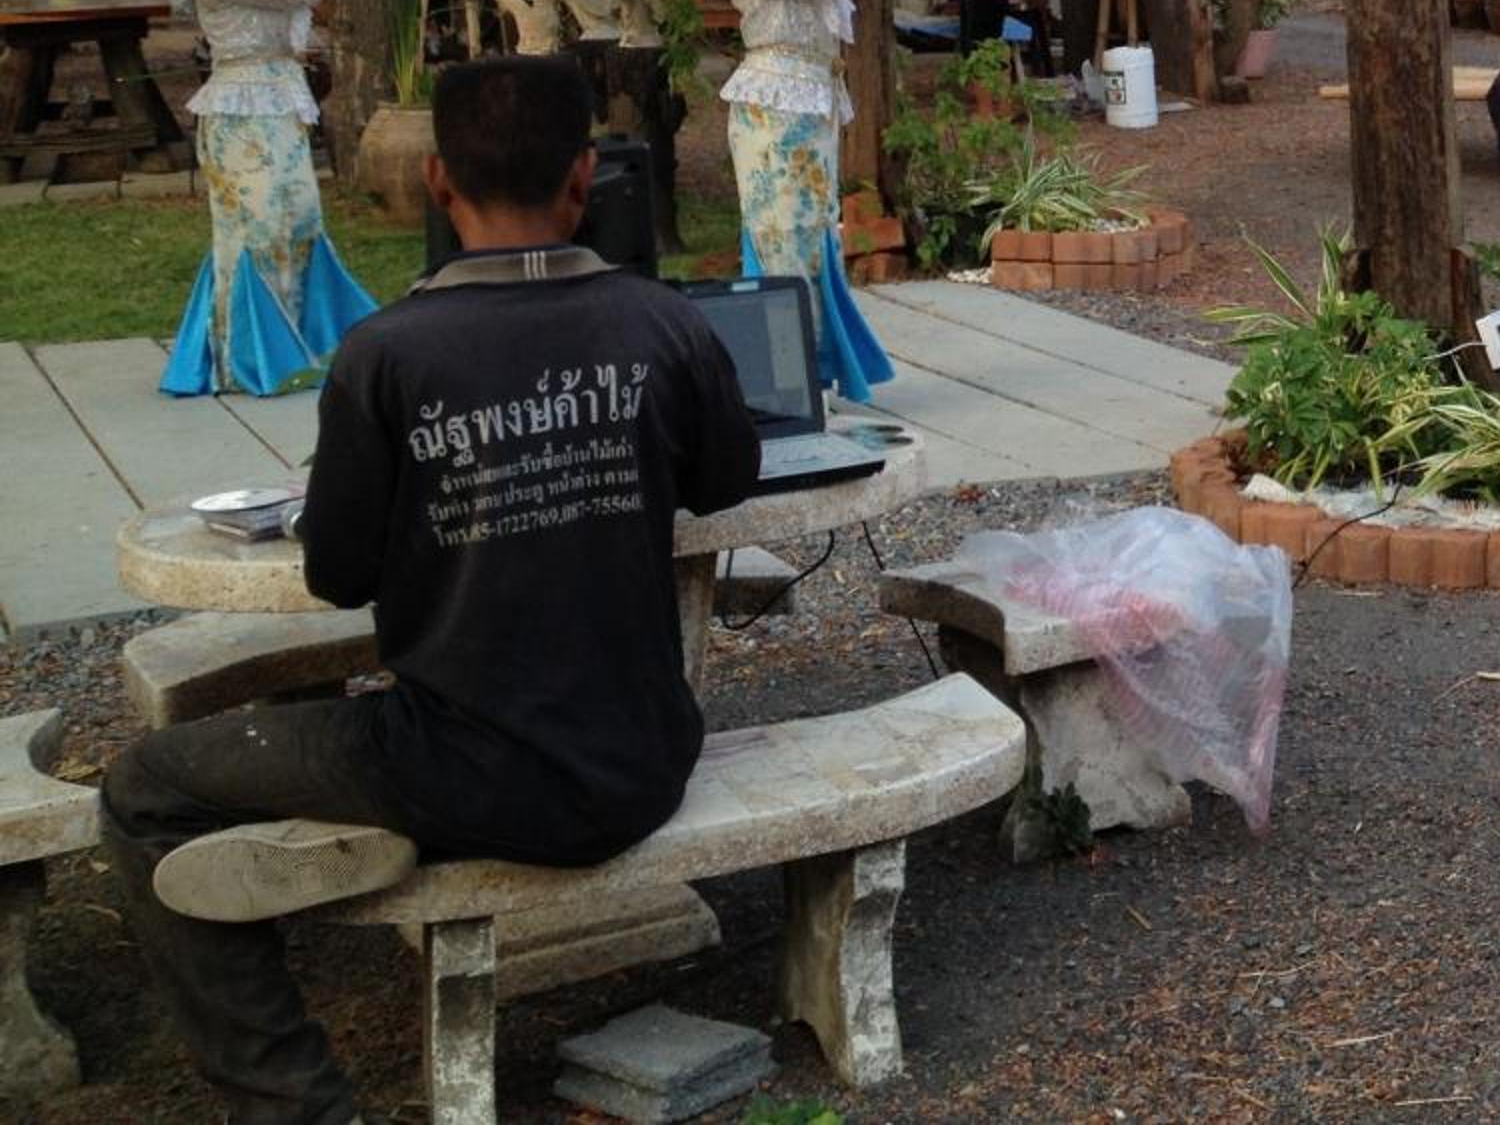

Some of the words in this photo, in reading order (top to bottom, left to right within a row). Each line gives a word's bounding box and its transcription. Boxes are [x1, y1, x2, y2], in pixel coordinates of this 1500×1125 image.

[409, 363, 649, 468] ณัฐพงษ์ค้าไม้
